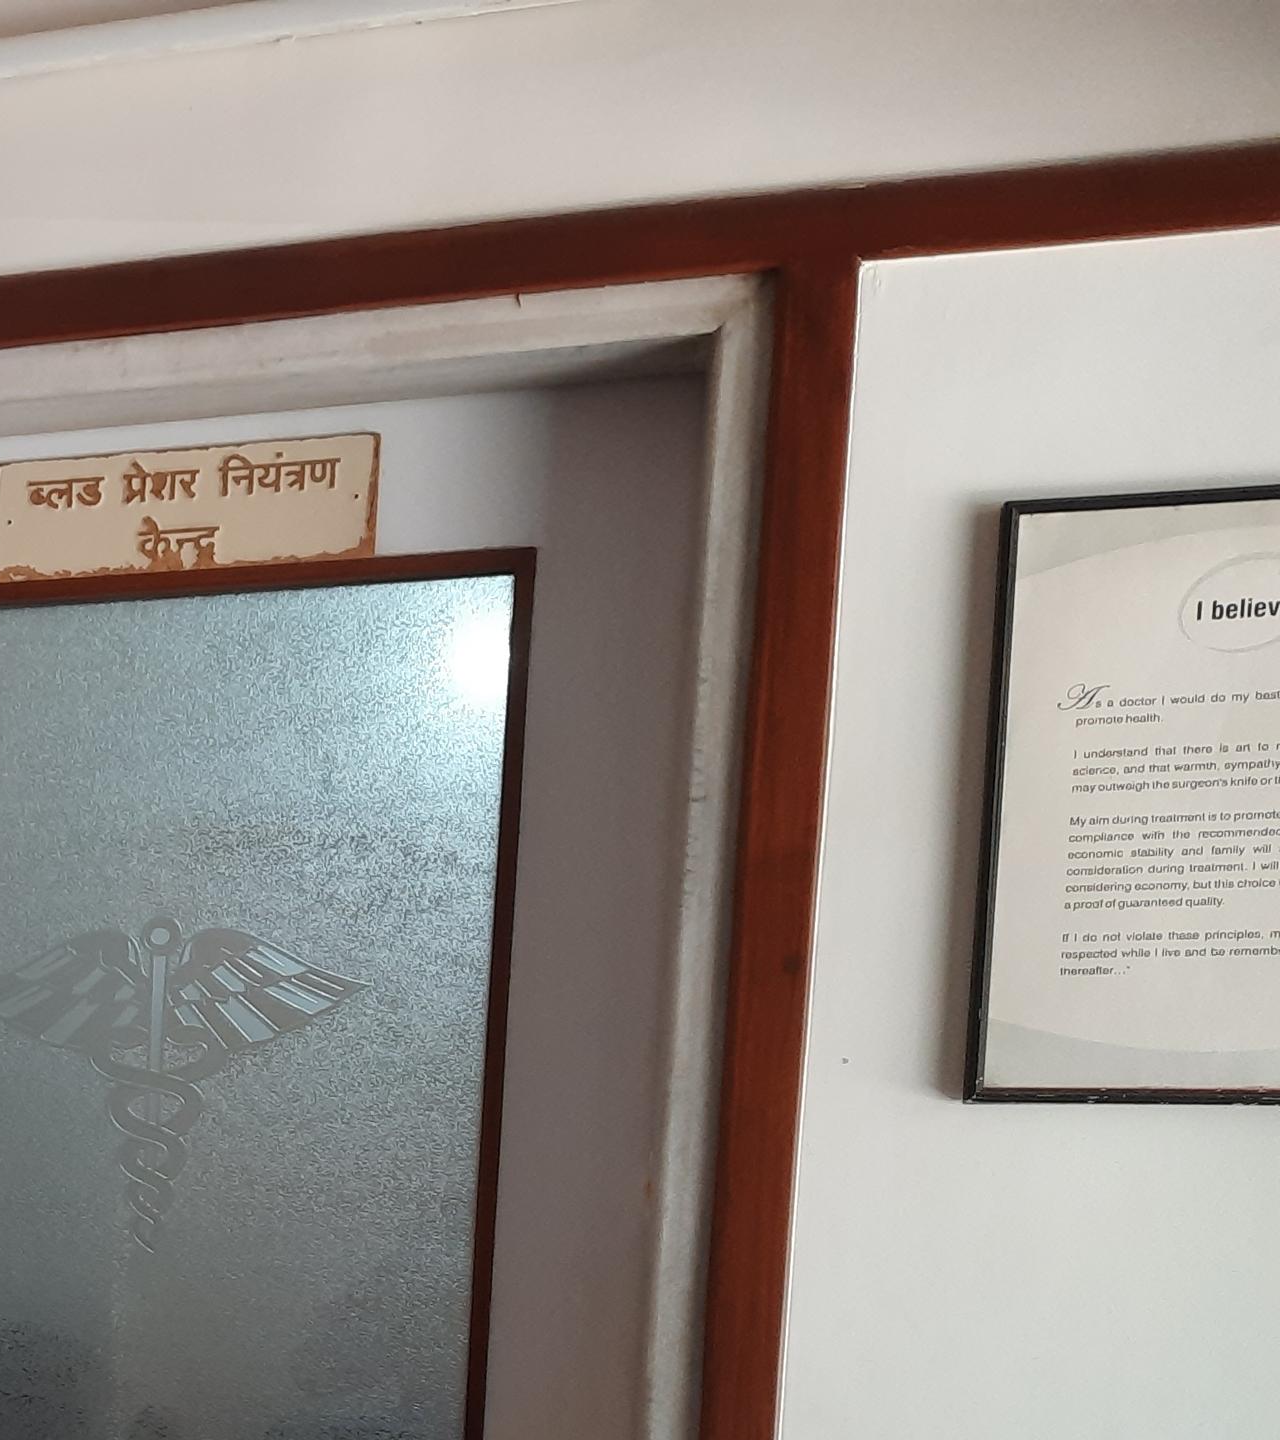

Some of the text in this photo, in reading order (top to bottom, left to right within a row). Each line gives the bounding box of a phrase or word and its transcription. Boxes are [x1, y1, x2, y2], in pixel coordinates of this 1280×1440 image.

[28, 451, 341, 510] ब्लड प्रेशर नियंत्रण
[1196, 600, 1203, 621] I
[1119, 697, 1157, 708] doctor
[1170, 694, 1205, 705] would
[1210, 693, 1226, 703] do
[1232, 693, 1250, 704] my
[1075, 713, 1164, 728] promote health.
[1083, 747, 1148, 759] understand
[1155, 746, 1176, 756] that
[1183, 743, 1213, 755] there
[1219, 742, 1229, 753] is
[1235, 743, 1251, 753] art
[1258, 742, 1269, 751] to
[1072, 765, 1119, 777] science,
[1123, 763, 1145, 774] and
[1149, 762, 1170, 773] that
[1174, 760, 1220, 772] warmth,
[1072, 783, 1095, 794] may
[1098, 780, 1150, 793] outweigh
[1152, 779, 1170, 789] the
[1172, 777, 1228, 790] surgeon's
[1230, 775, 1258, 787] knife
[1260, 777, 1273, 786] or
[1069, 816, 1087, 828] My
[1089, 815, 1109, 825] aim
[1112, 814, 1148, 826] during
[1151, 812, 1205, 824] treatment
[1208, 812, 1217, 822] is
[1220, 811, 1231, 821] to
[1068, 831, 1134, 844] compliance
[1142, 830, 1165, 840] with
[1172, 829, 1191, 840] the
[1067, 844, 1272, 860] economic stability and family will
[1066, 865, 1143, 876] consideration
[1147, 863, 1185, 875] during
[1189, 861, 1248, 873] treatment.
[1260, 861, 1279, 871] will
[1065, 877, 1276, 894] considering economy, but this choice
[1064, 897, 1225, 911] a proof of guaranteed quality.
[1062, 933, 1069, 943] If
[1082, 932, 1098, 942] do
[1103, 932, 1121, 942] not
[1126, 931, 1163, 941] violate
[1168, 930, 1200, 941] these
[1204, 929, 1264, 943] principles,
[1061, 949, 1117, 961] respected
[1121, 948, 1151, 958] while
[1161, 947, 1181, 957] live
[1184, 946, 1207, 957] and
[1210, 946, 1226, 956] be
